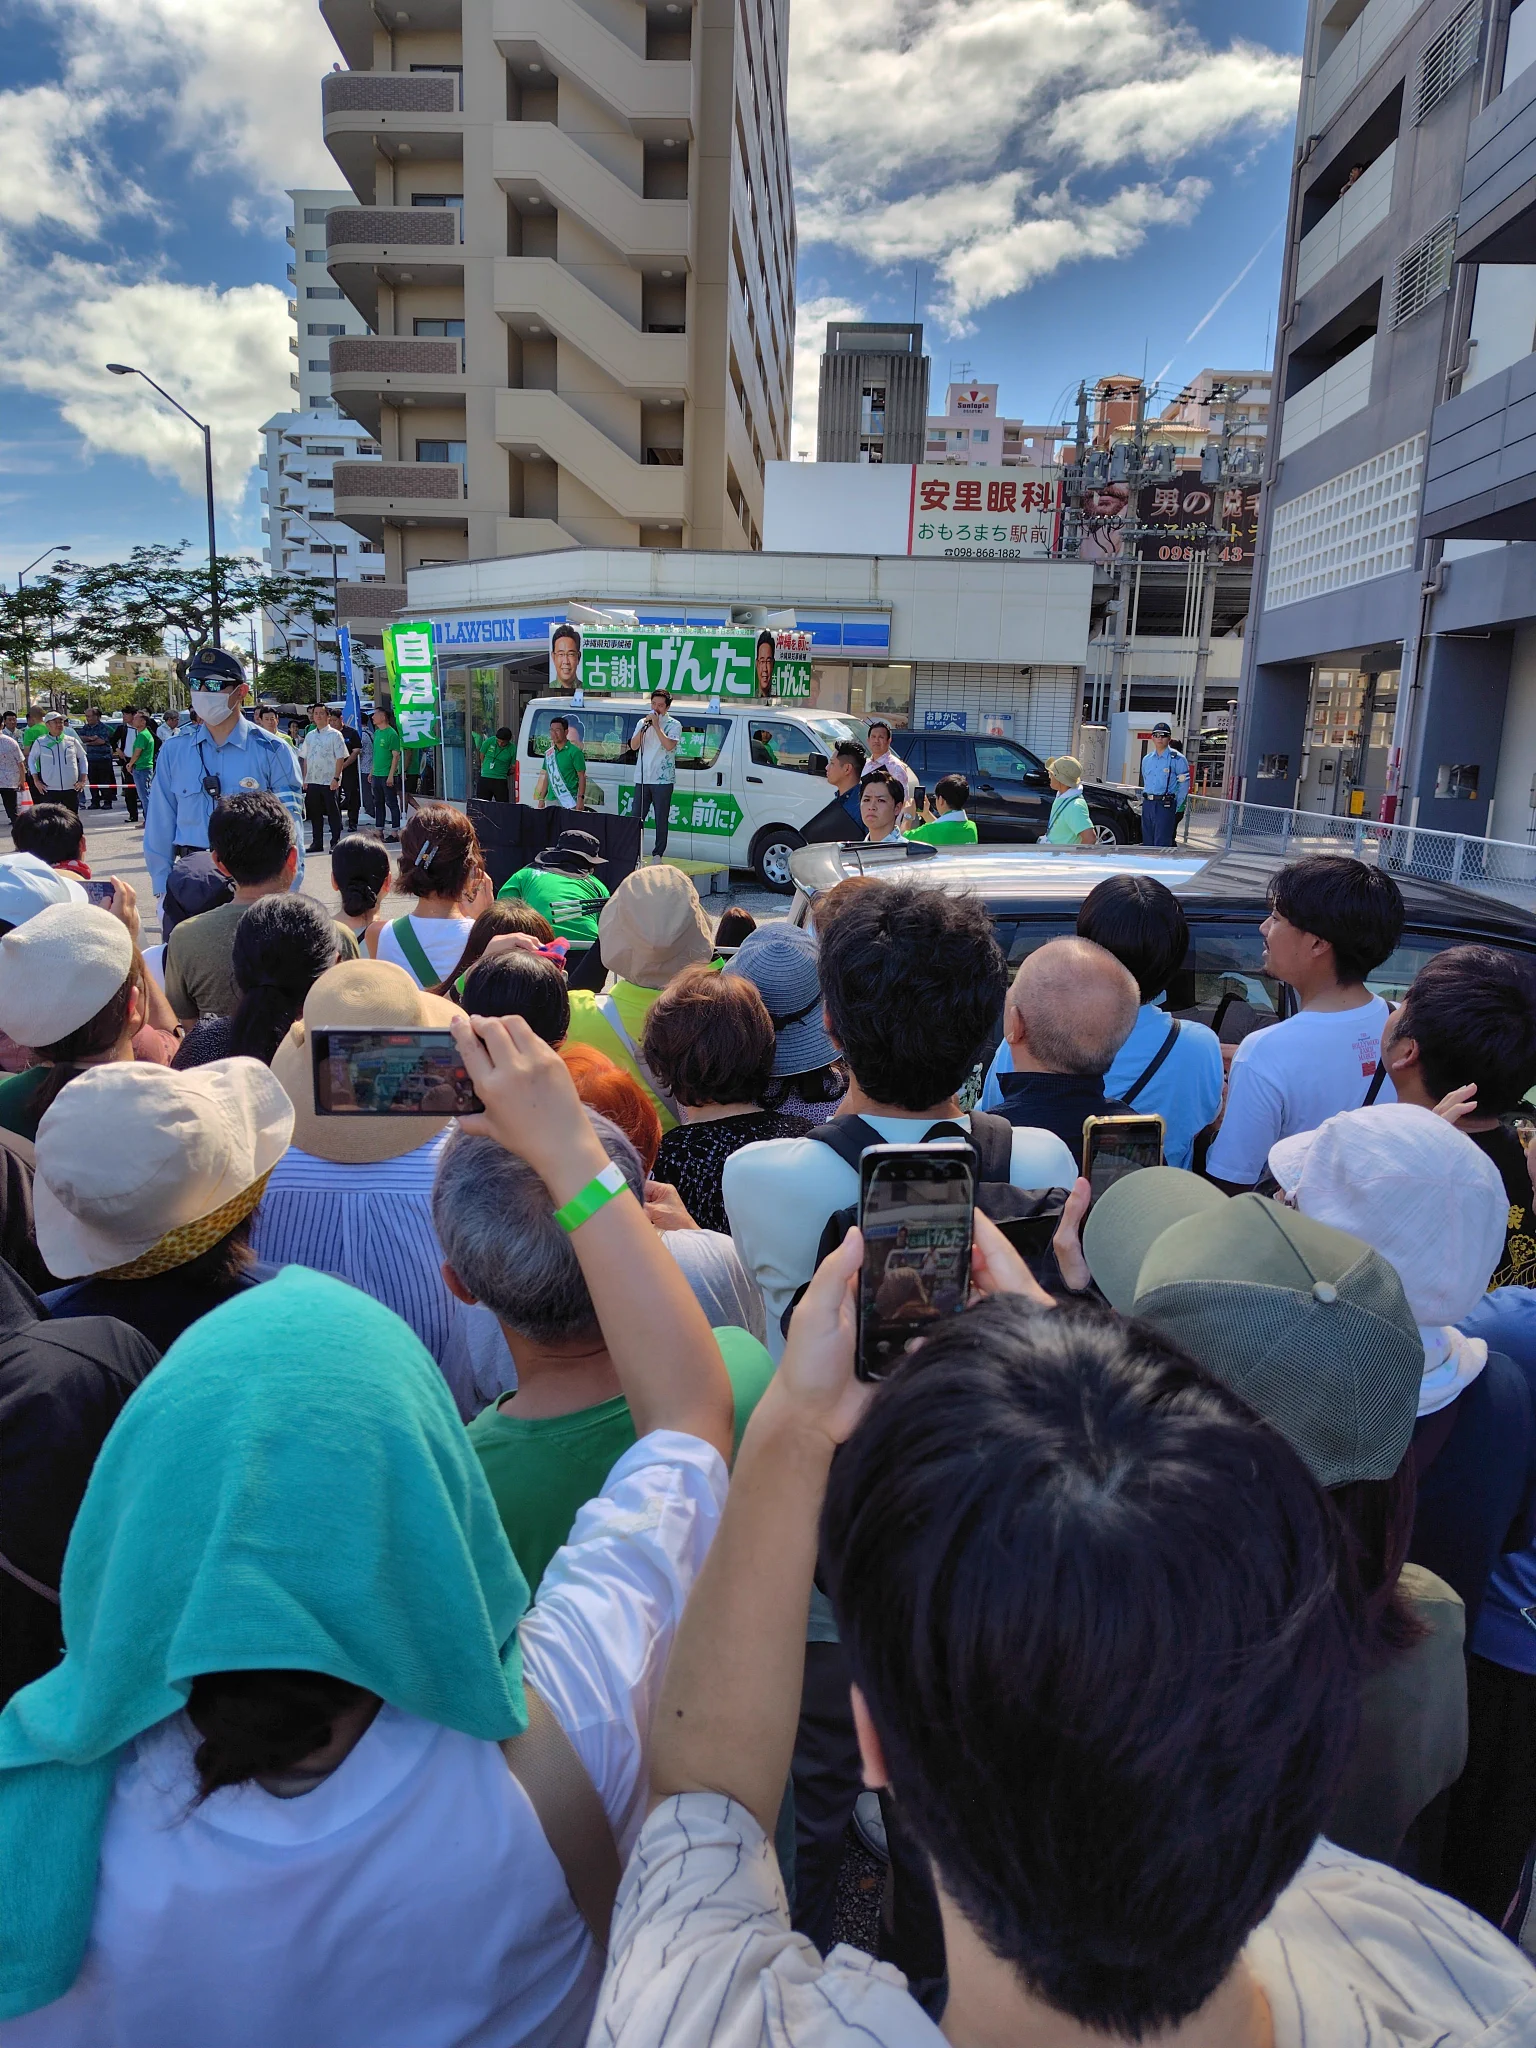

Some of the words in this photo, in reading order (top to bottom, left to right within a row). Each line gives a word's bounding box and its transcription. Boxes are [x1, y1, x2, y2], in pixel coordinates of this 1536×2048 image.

[920, 479, 1053, 513] 安里眼科
[918, 523, 1048, 543] おもろまち駅前
[445, 618, 516, 644] LAWSON
[585, 655, 637, 688] 古謝
[637, 636, 751, 695] げんた
[777, 663, 810, 697] げんた
[620, 791, 737, 830] を、前に!
